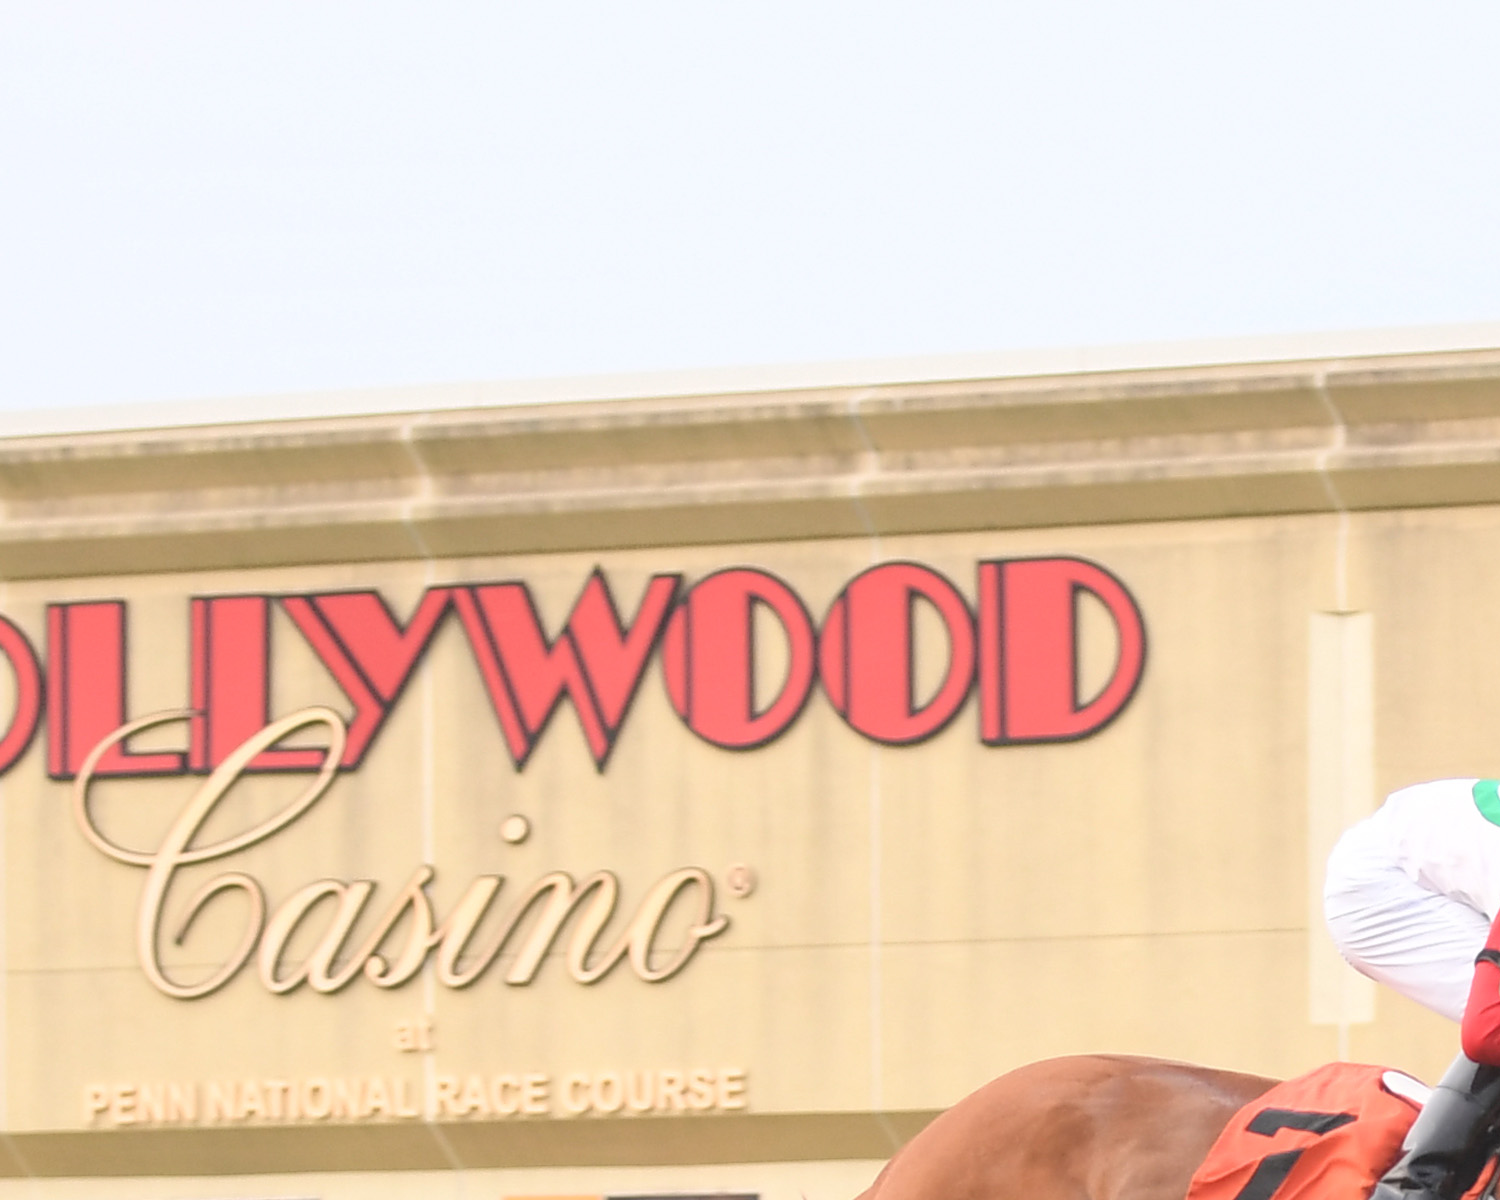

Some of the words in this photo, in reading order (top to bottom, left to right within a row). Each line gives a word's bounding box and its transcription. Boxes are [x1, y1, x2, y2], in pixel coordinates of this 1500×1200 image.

[395, 1020, 433, 1053] at
[84, 1081, 199, 1126] PENN
[200, 1076, 421, 1121] NATIONAL
[432, 1072, 550, 1117] RACE
[566, 1067, 748, 1113] COURSE
